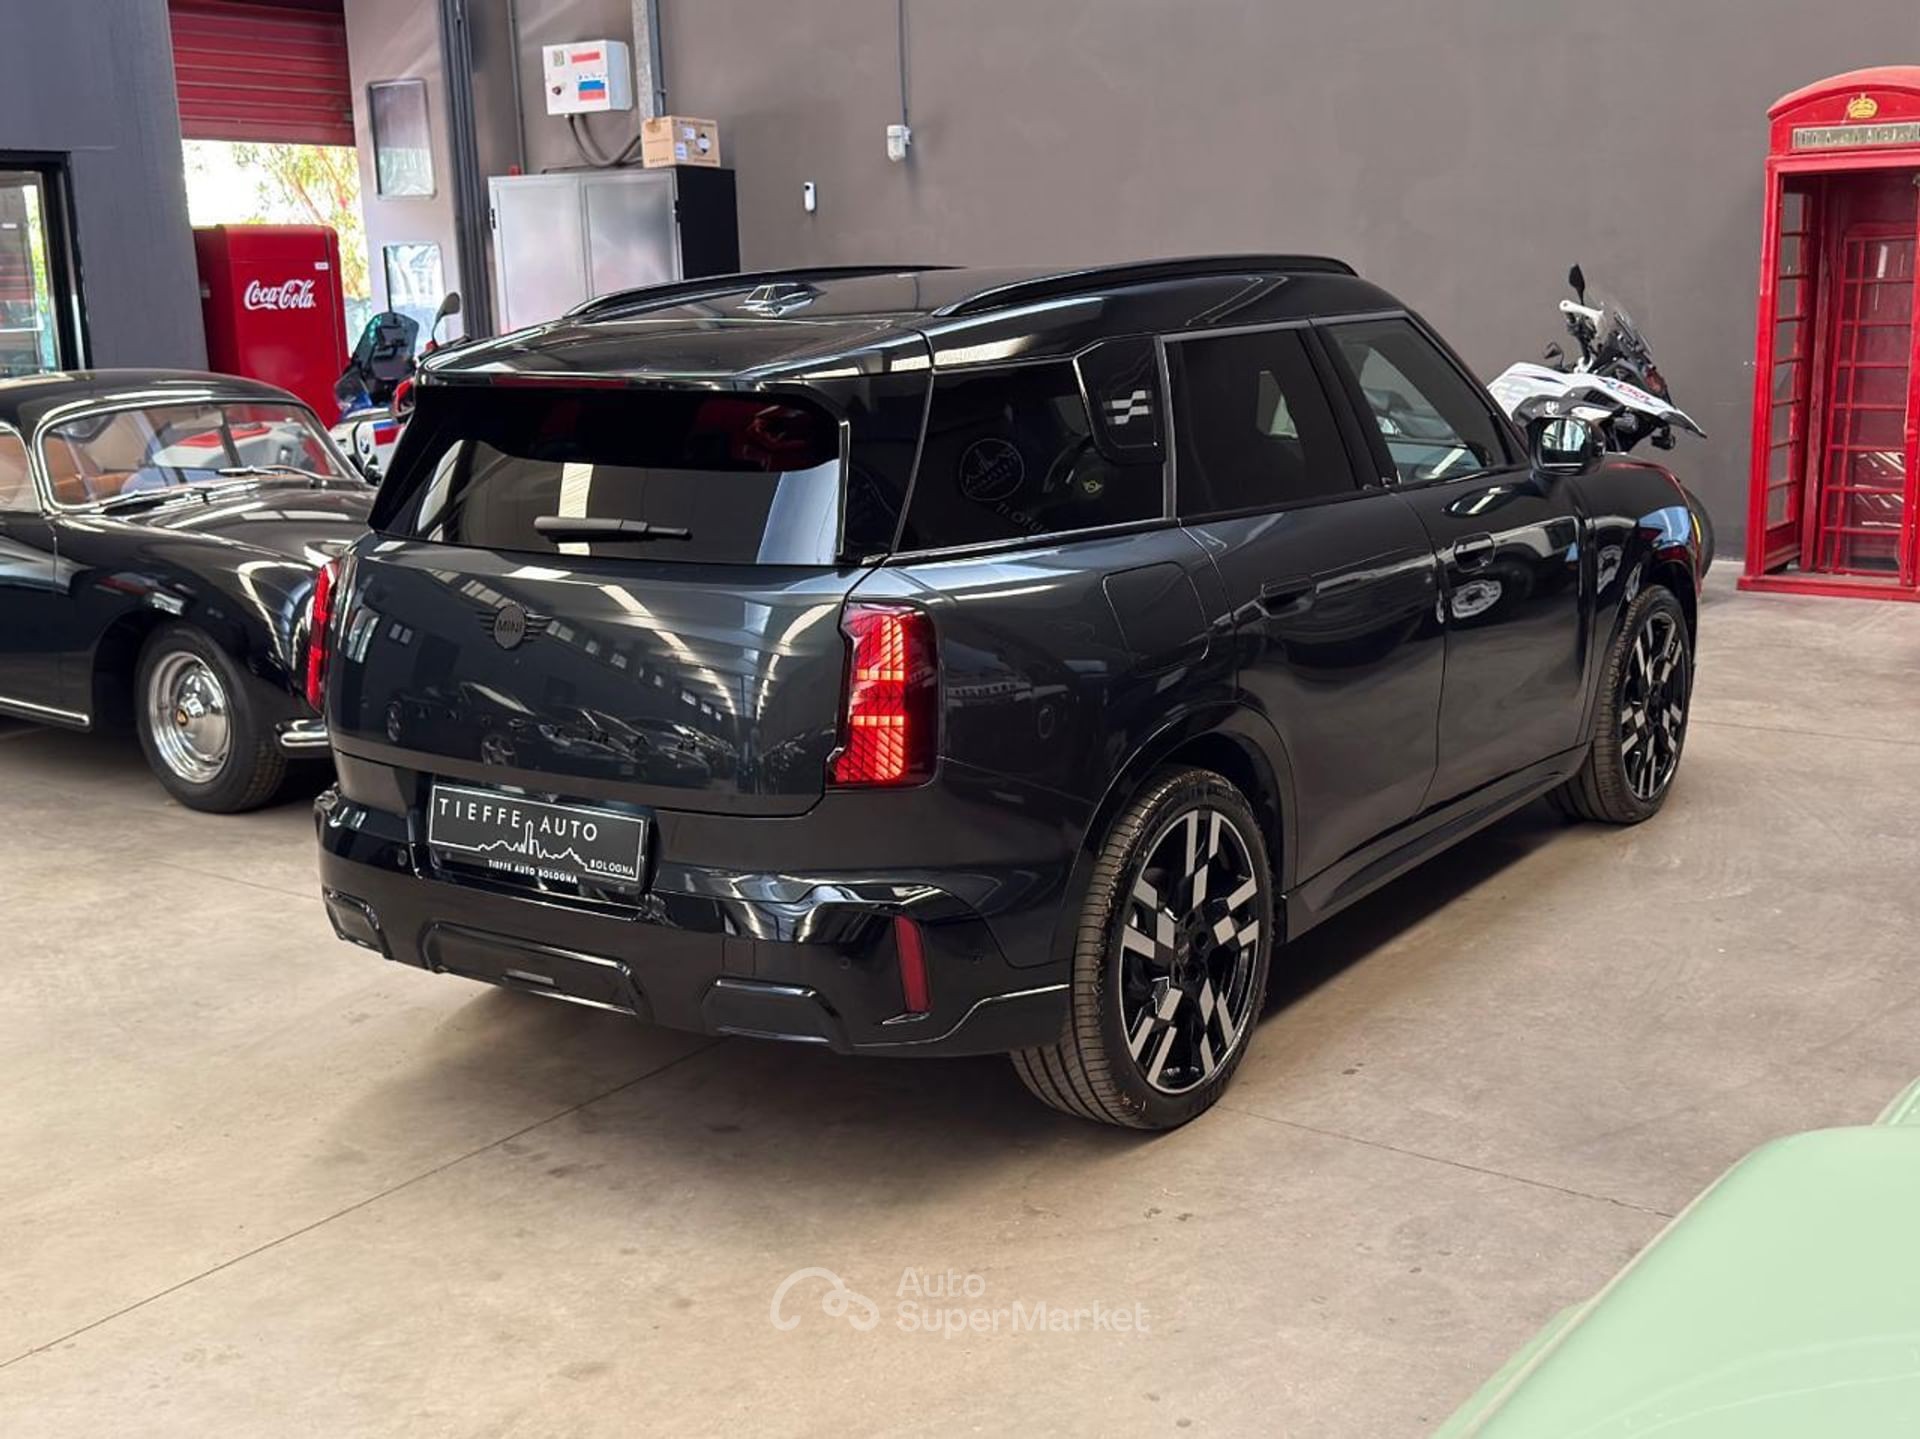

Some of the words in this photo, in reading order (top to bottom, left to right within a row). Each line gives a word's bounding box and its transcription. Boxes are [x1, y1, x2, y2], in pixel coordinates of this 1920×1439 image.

[244, 280, 317, 310] Coca-Cola
[439, 798, 521, 829] TIEFFE
[539, 815, 598, 842] AUTO
[488, 859, 512, 871] TIEFFE
[514, 864, 535, 876] AUTO
[538, 869, 578, 884] BOLOGNA
[590, 859, 635, 876] BOLOGNA
